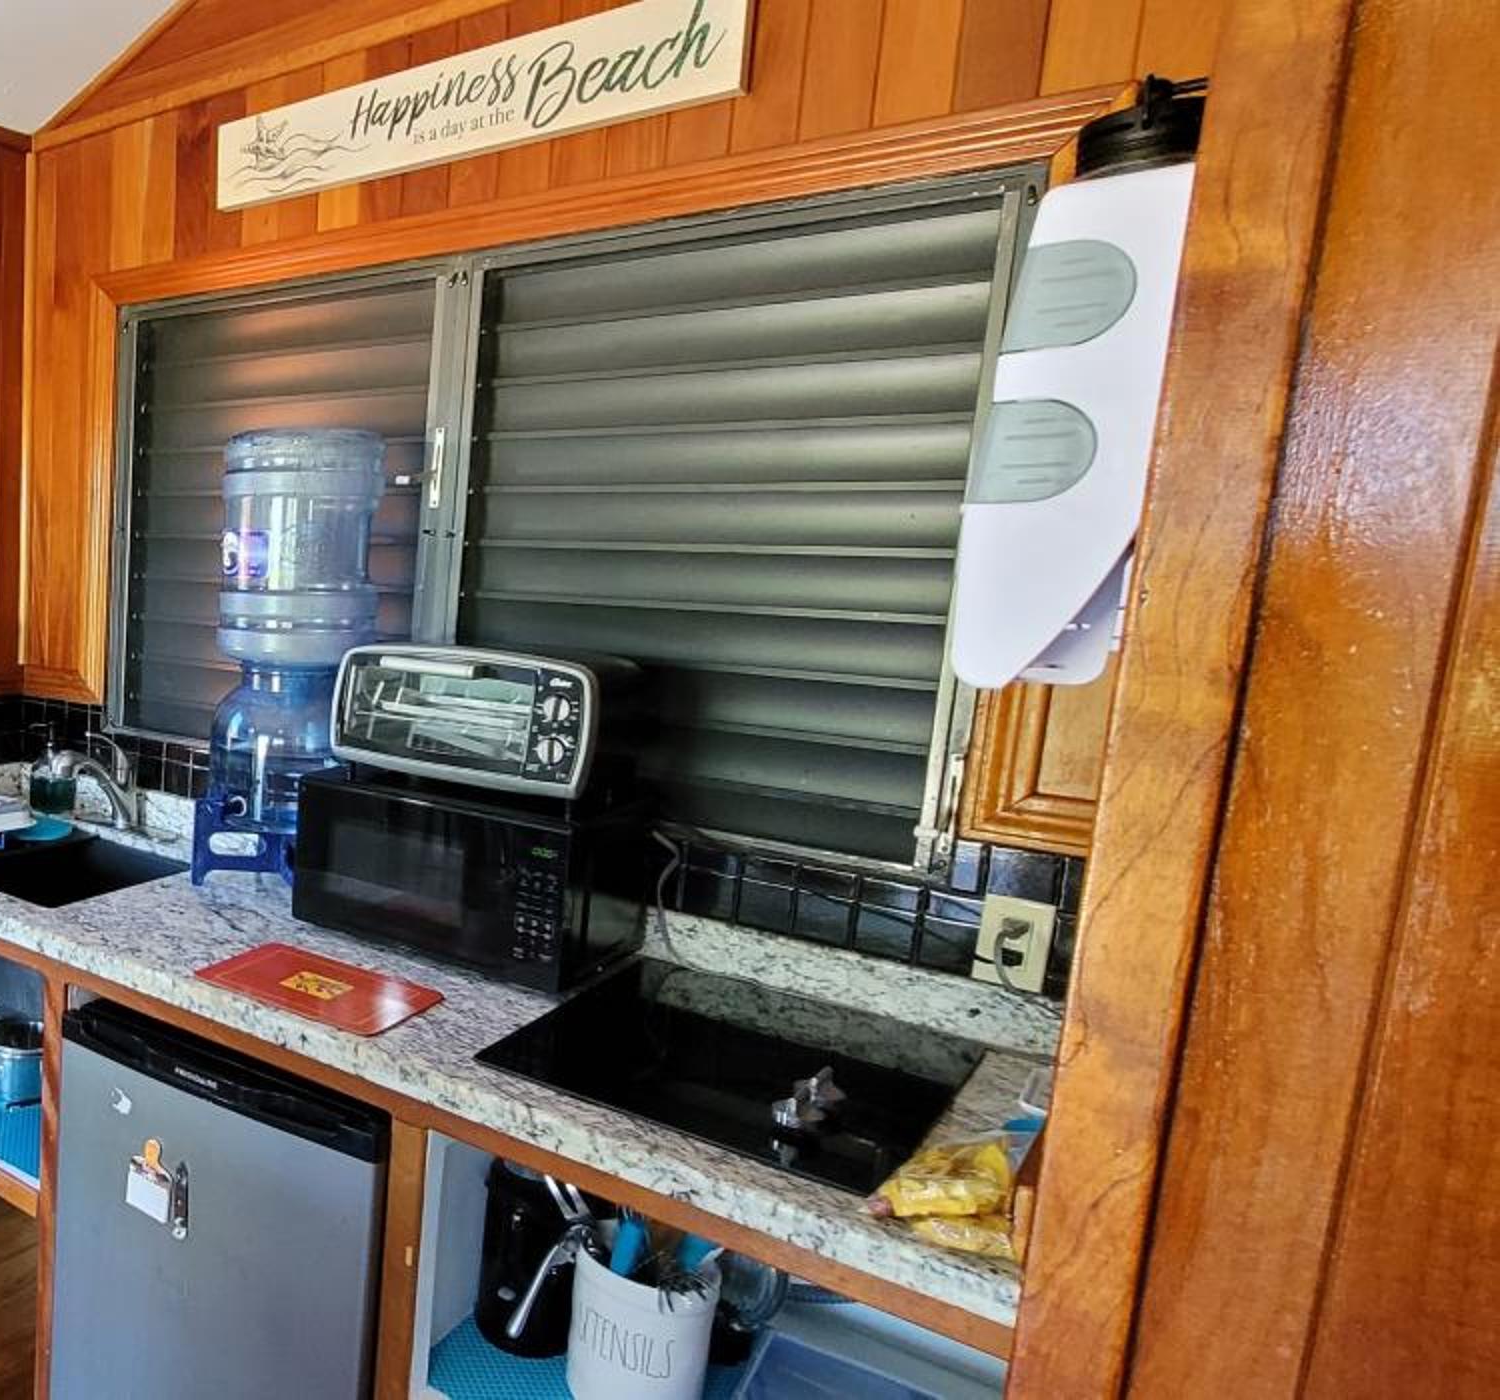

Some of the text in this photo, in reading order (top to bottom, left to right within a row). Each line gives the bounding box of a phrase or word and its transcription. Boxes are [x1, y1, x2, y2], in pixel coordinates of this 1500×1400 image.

[350, 54, 522, 141] Happiness
[524, 0, 727, 128] Beach
[414, 107, 515, 144] is a day at the
